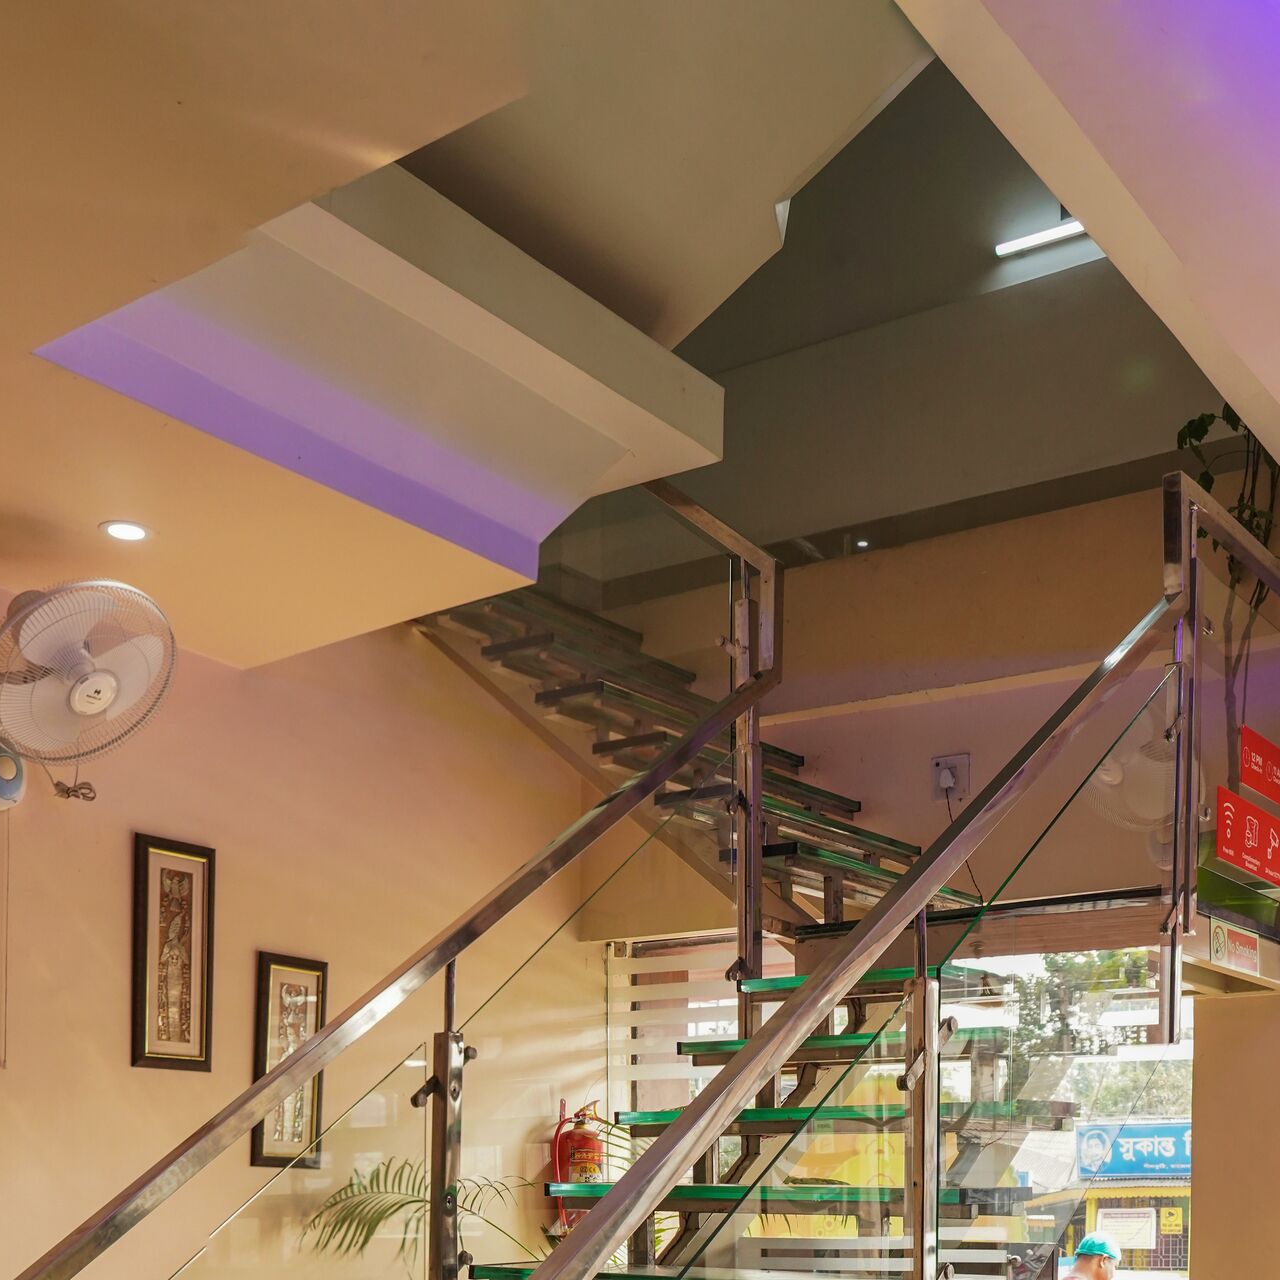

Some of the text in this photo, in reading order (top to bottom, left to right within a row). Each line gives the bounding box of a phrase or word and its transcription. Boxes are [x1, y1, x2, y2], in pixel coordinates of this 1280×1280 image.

[1227, 939, 1257, 962] No Smoking
[1116, 1135, 1176, 1161] সুকান্ত
